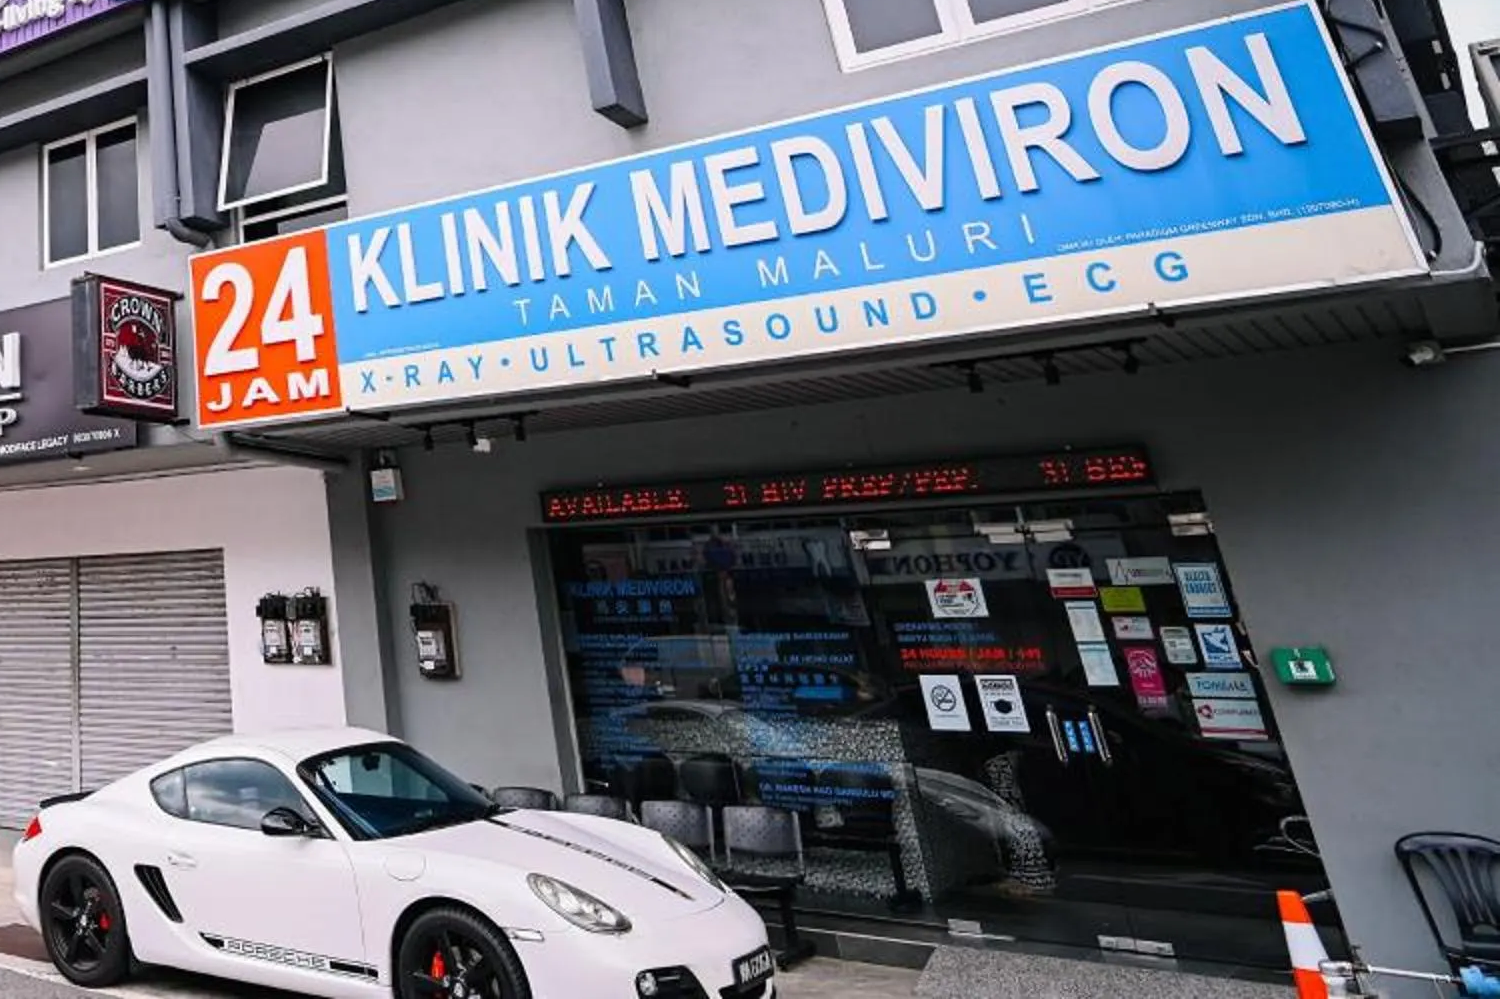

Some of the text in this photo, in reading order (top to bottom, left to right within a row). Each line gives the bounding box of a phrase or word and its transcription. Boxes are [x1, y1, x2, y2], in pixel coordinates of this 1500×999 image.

[347, 32, 1307, 315] KLINIK MEDIVIRON
[112, 297, 162, 333] CROWN
[201, 246, 325, 377] 24
[514, 213, 1036, 326] TAMAN MALURI
[530, 290, 938, 372] ULTRASOUND
[1023, 250, 1190, 303] ECG
[206, 369, 331, 413] JAM
[226, 938, 327, 969] PORSCHE
